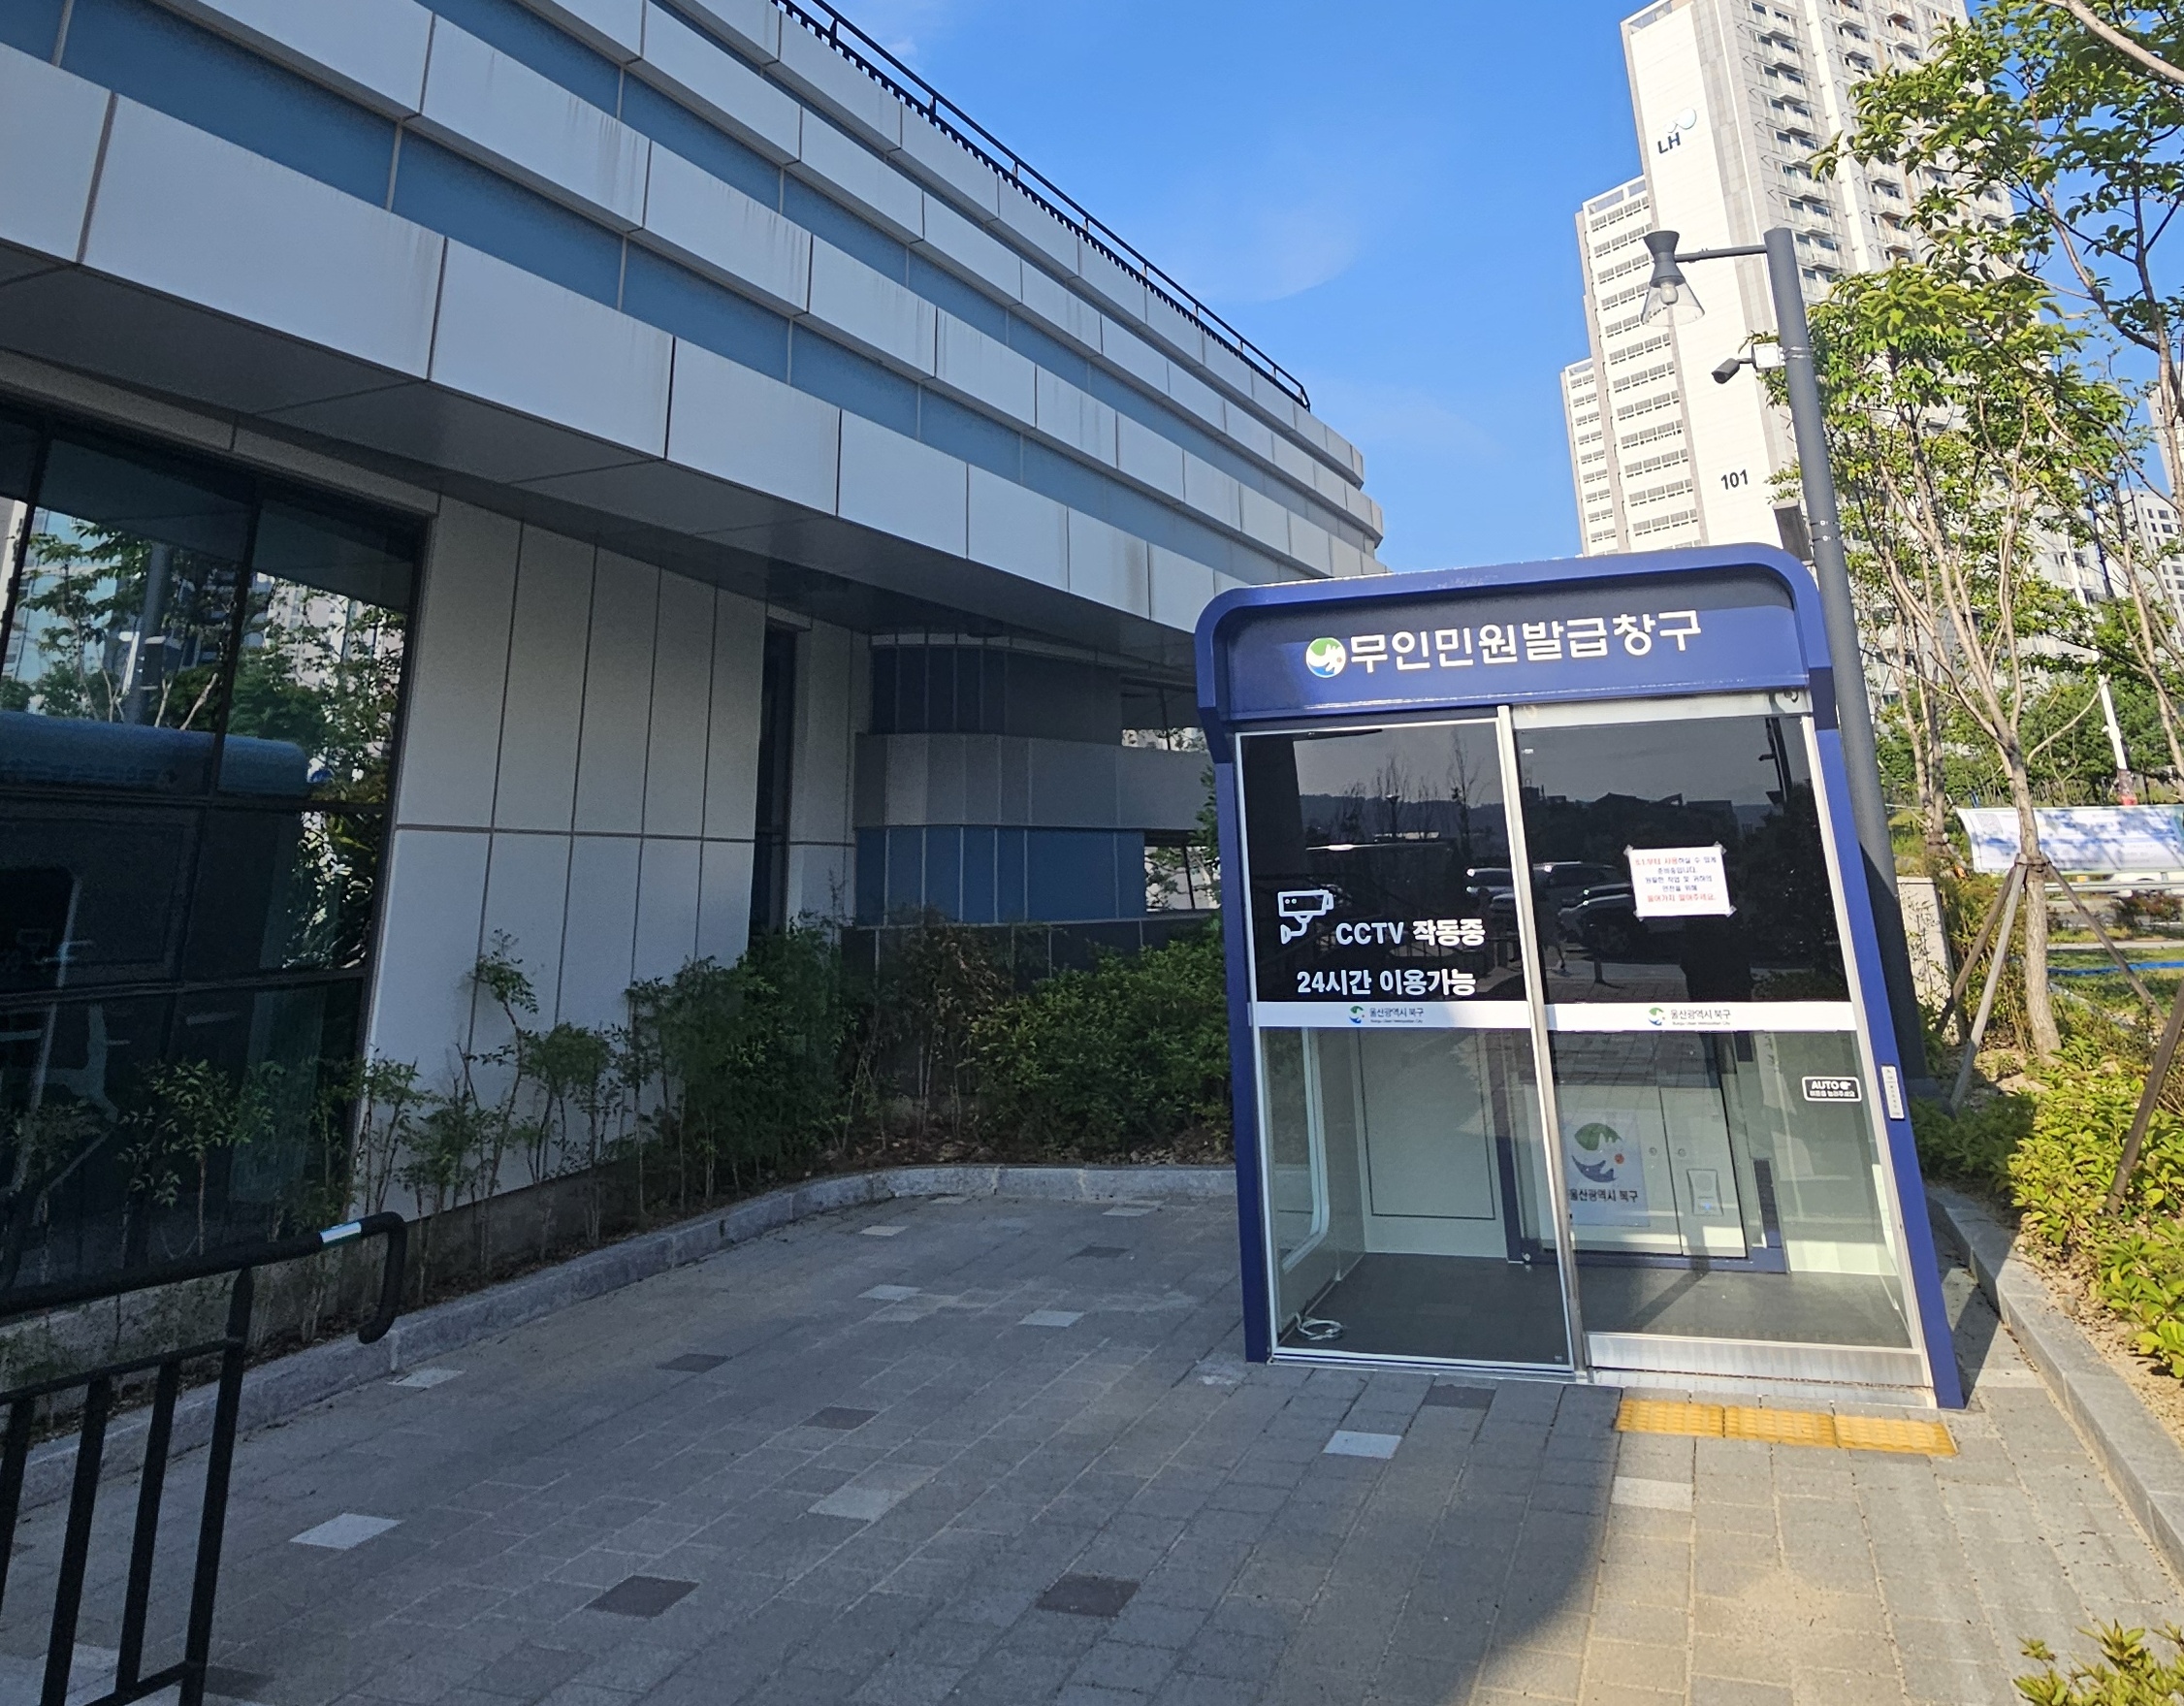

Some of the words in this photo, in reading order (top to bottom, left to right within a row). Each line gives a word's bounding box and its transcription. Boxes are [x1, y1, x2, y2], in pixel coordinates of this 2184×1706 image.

[1657, 132, 1681, 154] LH
[1720, 468, 1749, 491] 101
[1350, 610, 1702, 674] 무인민원발급창구
[1335, 921, 1404, 946] CCTV
[1412, 918, 1486, 947] 작동중
[1297, 969, 1372, 996] 24시간
[1379, 968, 1477, 997] 이용가능
[1369, 1007, 1407, 1018] 울산광역시
[1409, 1007, 1424, 1018] 북구
[1670, 1009, 1713, 1019] 울산광역시
[1714, 1009, 1731, 1019] 북구
[1811, 1080, 1840, 1090] AUTO
[1568, 1188, 1617, 1203] 울산광역시
[1619, 1190, 1638, 1203] 북구
